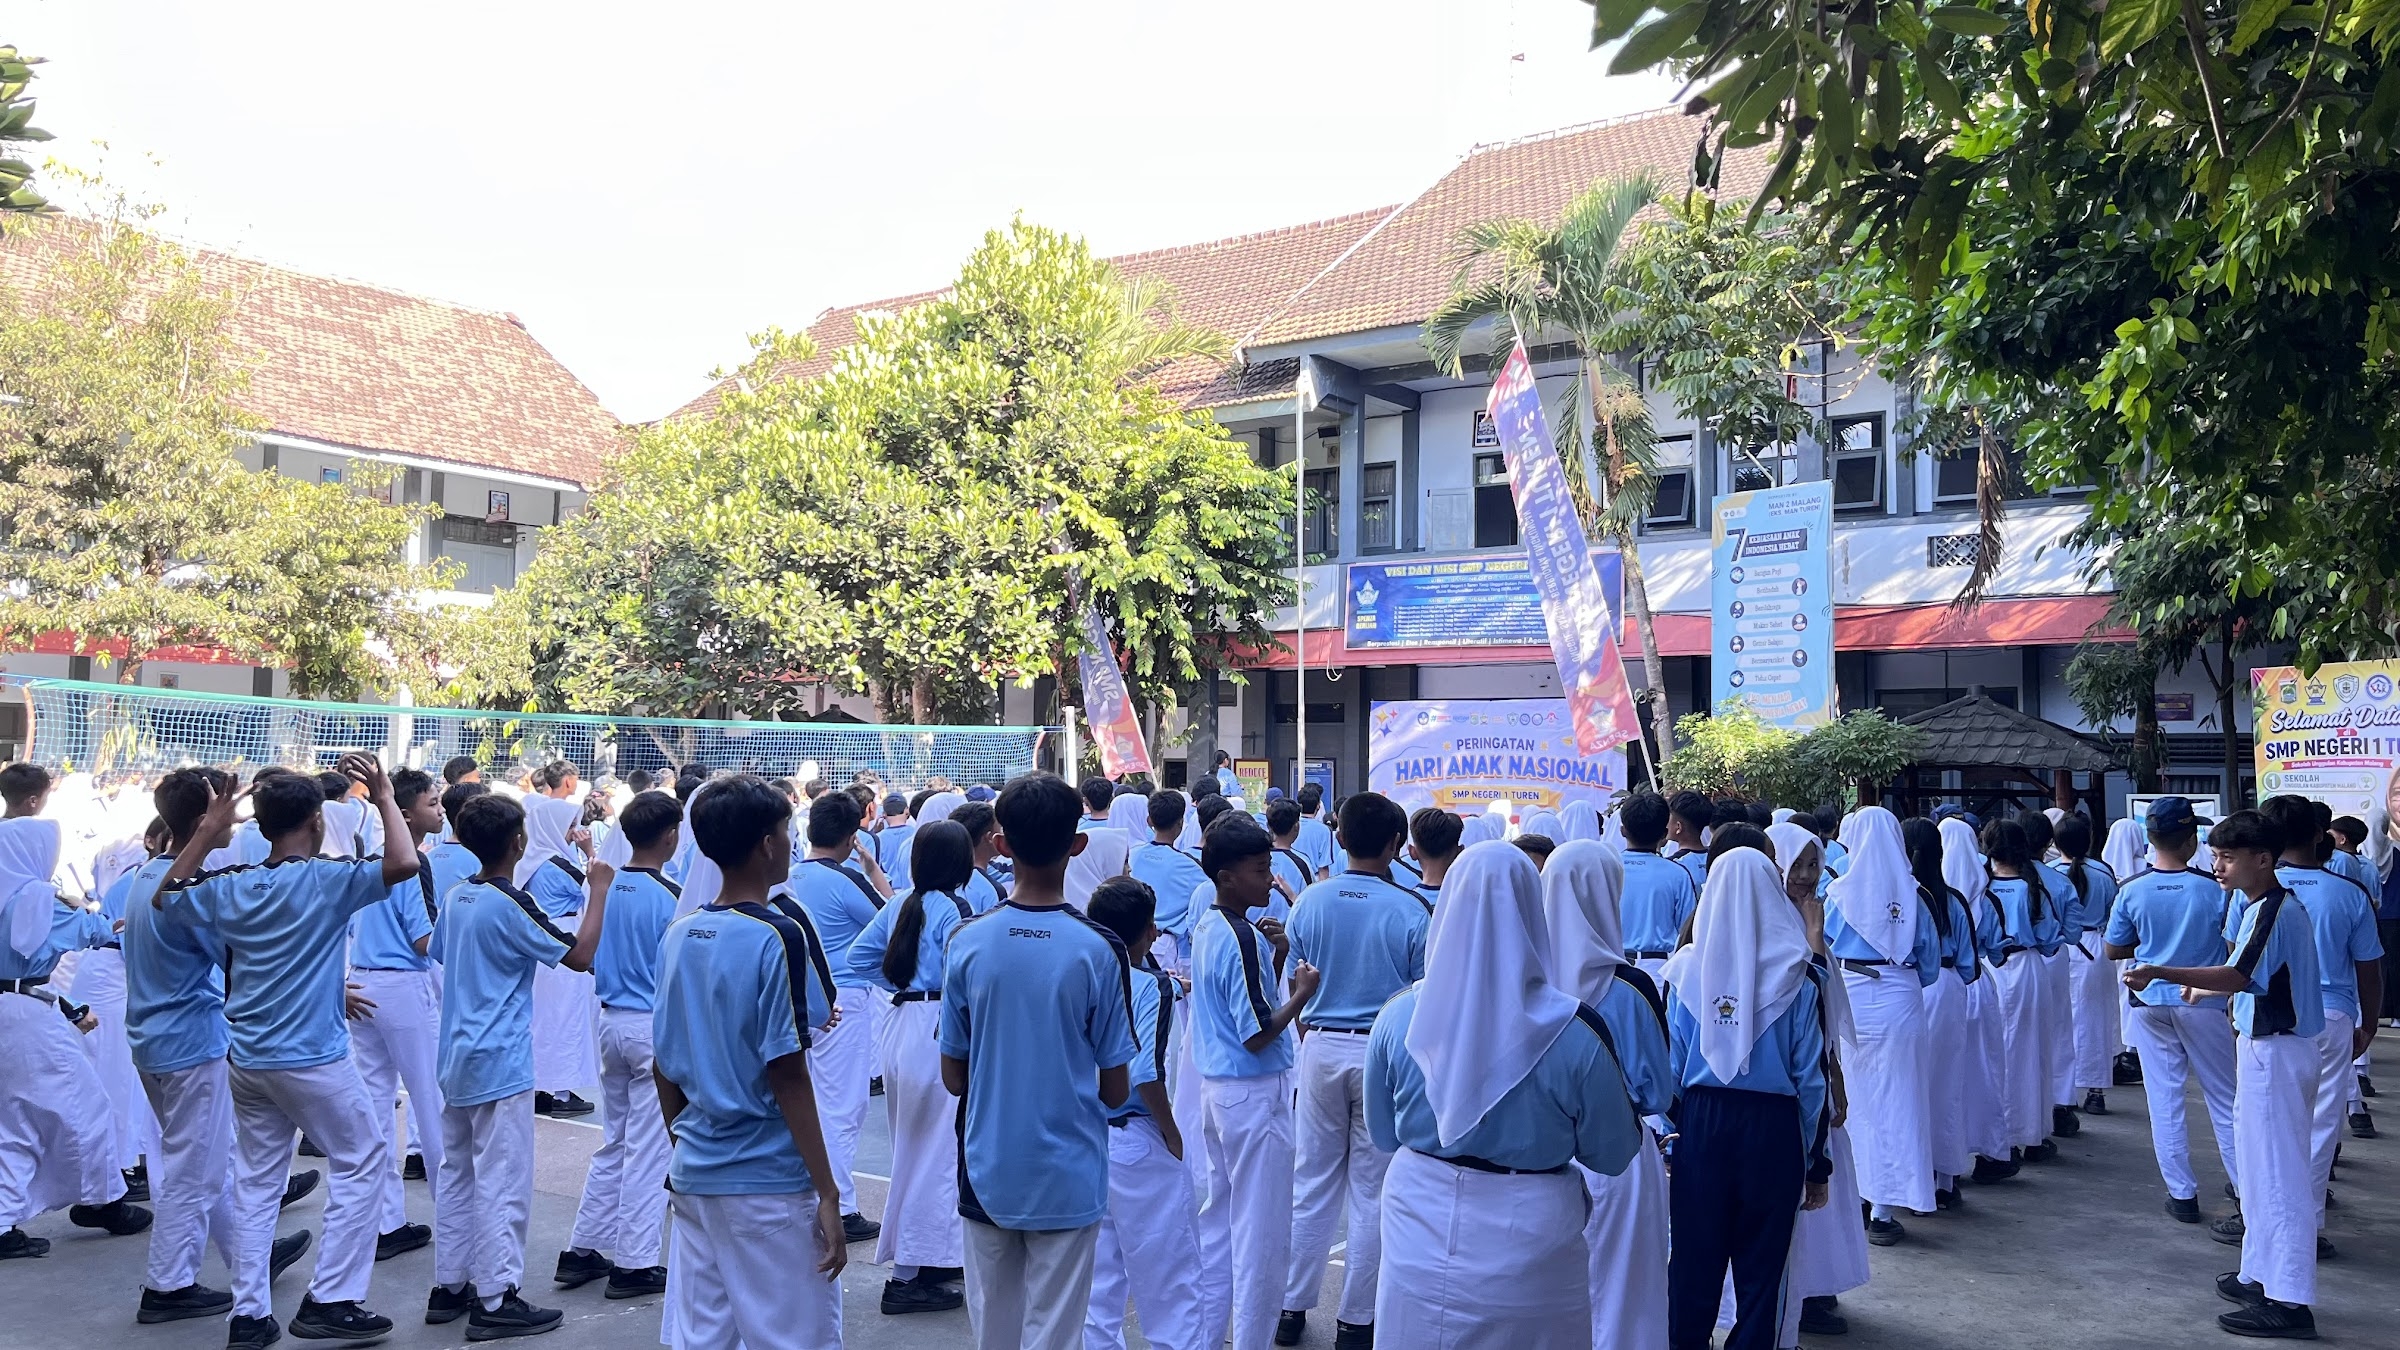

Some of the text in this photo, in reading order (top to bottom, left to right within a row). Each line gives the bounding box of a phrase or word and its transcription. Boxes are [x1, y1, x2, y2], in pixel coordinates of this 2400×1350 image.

[1768, 496, 1822, 510] MAN 2 MALANG
[1749, 531, 1800, 544] KEBIASAAN ANAK
[1727, 527, 1748, 562] 7
[1746, 542, 1800, 554] INDONESIA HEBAT
[1385, 566, 1406, 577] VISI
[1408, 565, 1432, 576] DAN
[1433, 564, 1458, 574] MISI
[2270, 708, 2352, 733] Selamat
[1456, 737, 1535, 751] PERINGATAN
[2266, 741, 2300, 760] SMP
[2305, 738, 2368, 757] NEGERI
[2372, 738, 2380, 755] 1
[2364, 760, 2384, 768] Malang
[1240, 768, 1266, 778] REDUCE
[1395, 754, 1613, 790] HARI ANAK NASIONAL
[2284, 774, 2320, 782] SEKOLAH
[2270, 774, 2276, 790] 1
[1452, 790, 1540, 800] SMP NEGERI 1 TUREN
[1338, 890, 1368, 899] SPENZA
[688, 929, 717, 939] SPENZA
[1009, 928, 1052, 939] SPENZA
